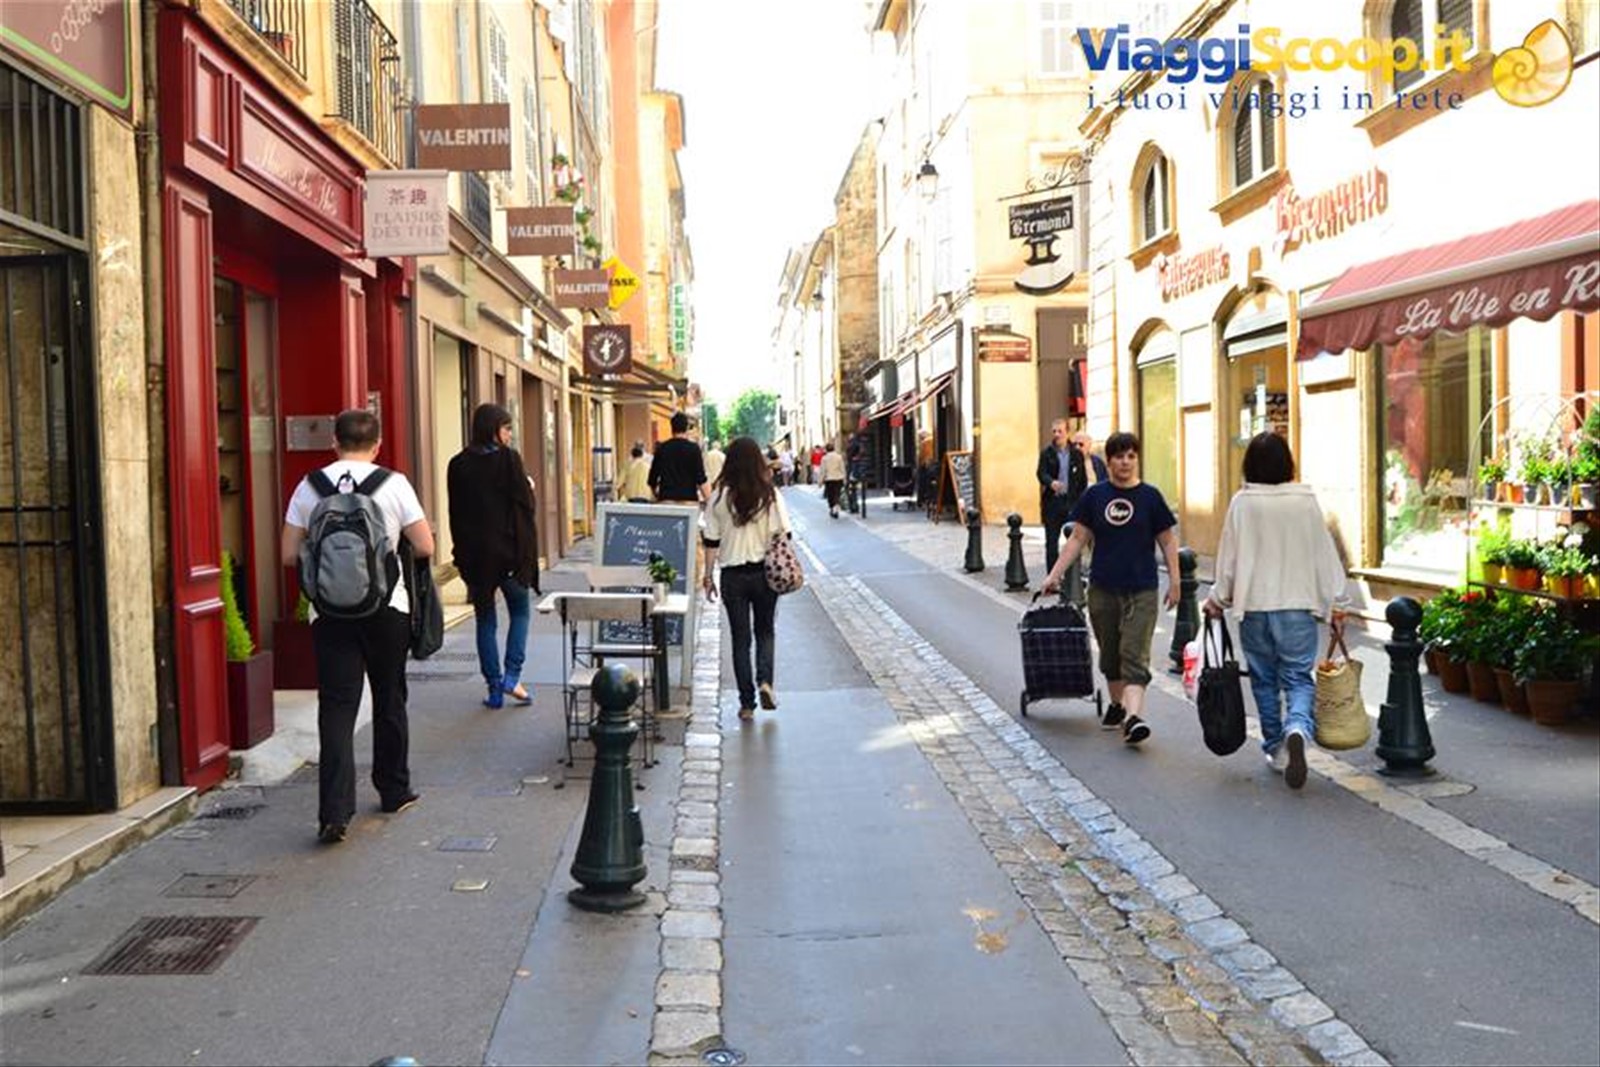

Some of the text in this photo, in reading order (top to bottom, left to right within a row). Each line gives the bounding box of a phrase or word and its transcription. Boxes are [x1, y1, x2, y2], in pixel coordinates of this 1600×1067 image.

[419, 128, 511, 147] VALENTIN
[509, 224, 575, 238] VALENTIN
[556, 282, 609, 295] VALENTIN
[674, 285, 685, 352] FLEURS
[1395, 299, 1441, 335] La
[1449, 287, 1500, 324] Vie
[1509, 287, 1551, 313] en
